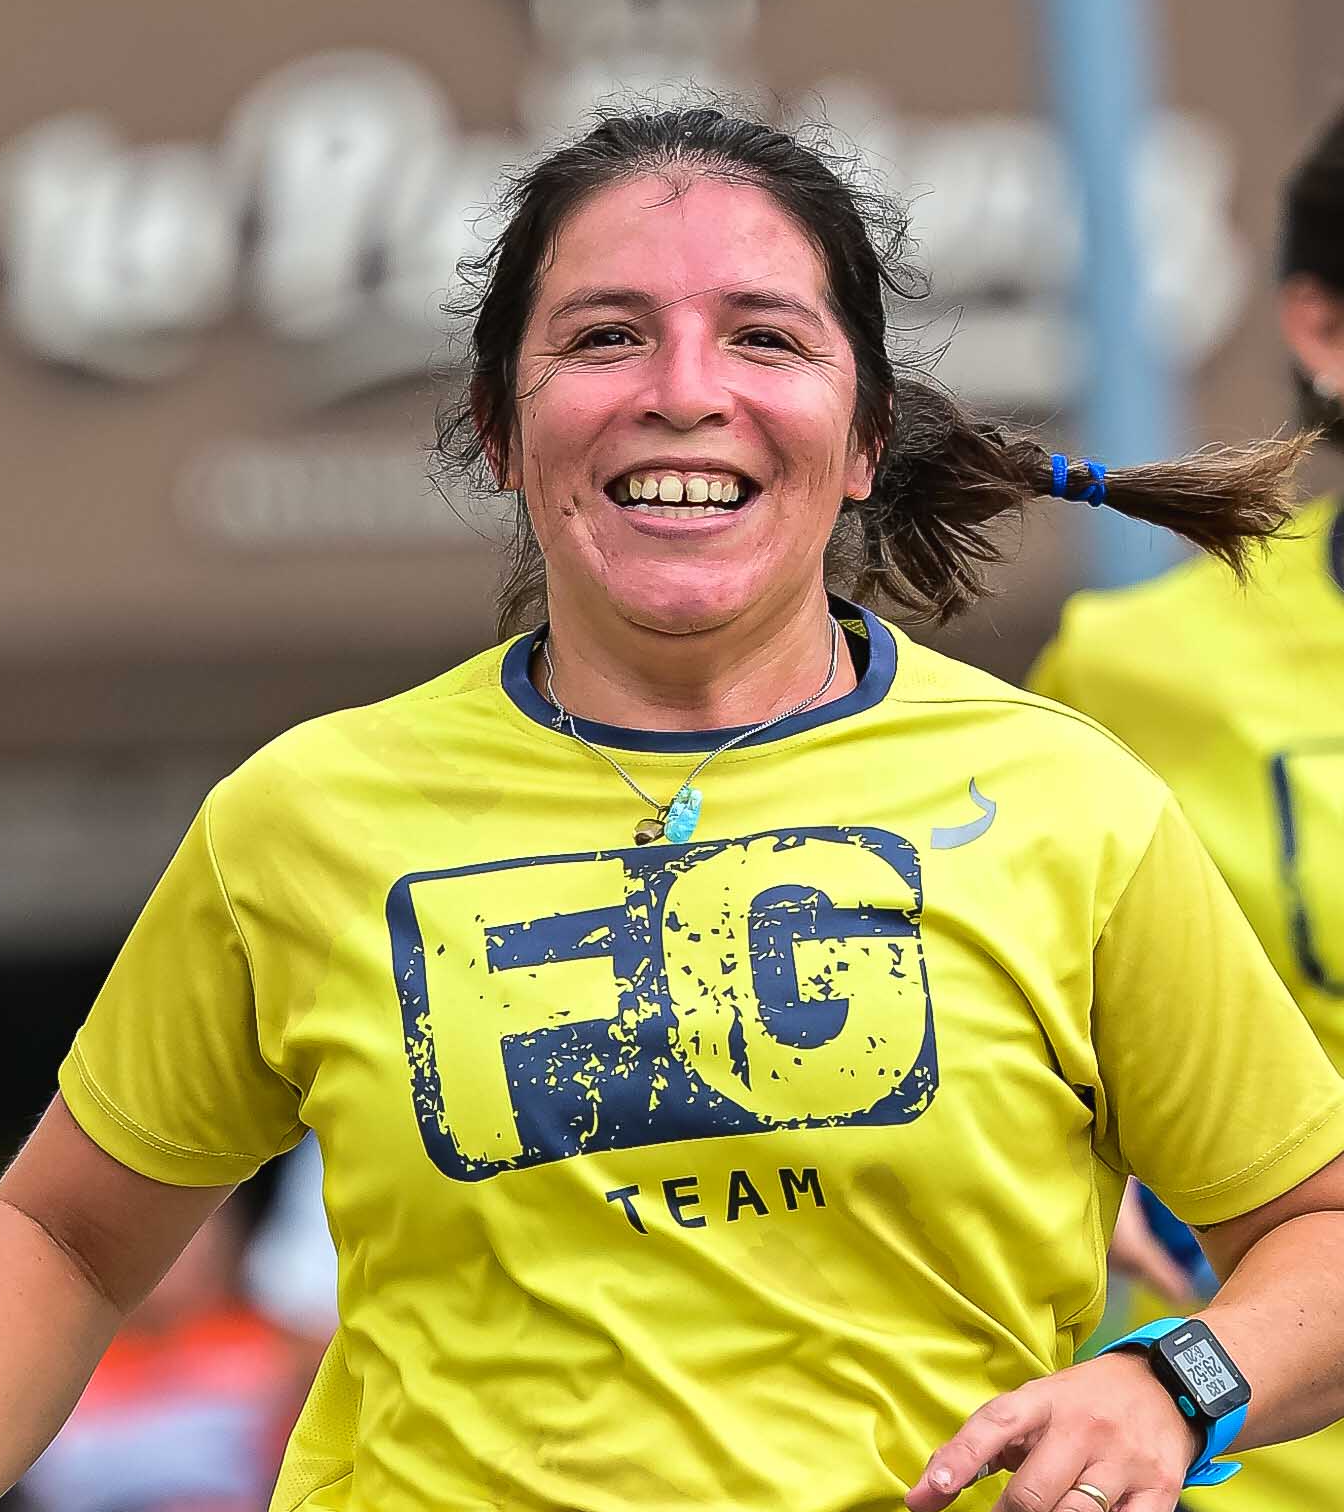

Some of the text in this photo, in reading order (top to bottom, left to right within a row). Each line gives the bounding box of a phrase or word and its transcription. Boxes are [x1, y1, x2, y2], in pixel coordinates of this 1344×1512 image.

[406, 838, 928, 1164] FG
[605, 1167, 827, 1236] TEAM
[1188, 1356, 1222, 1385] 29:52
